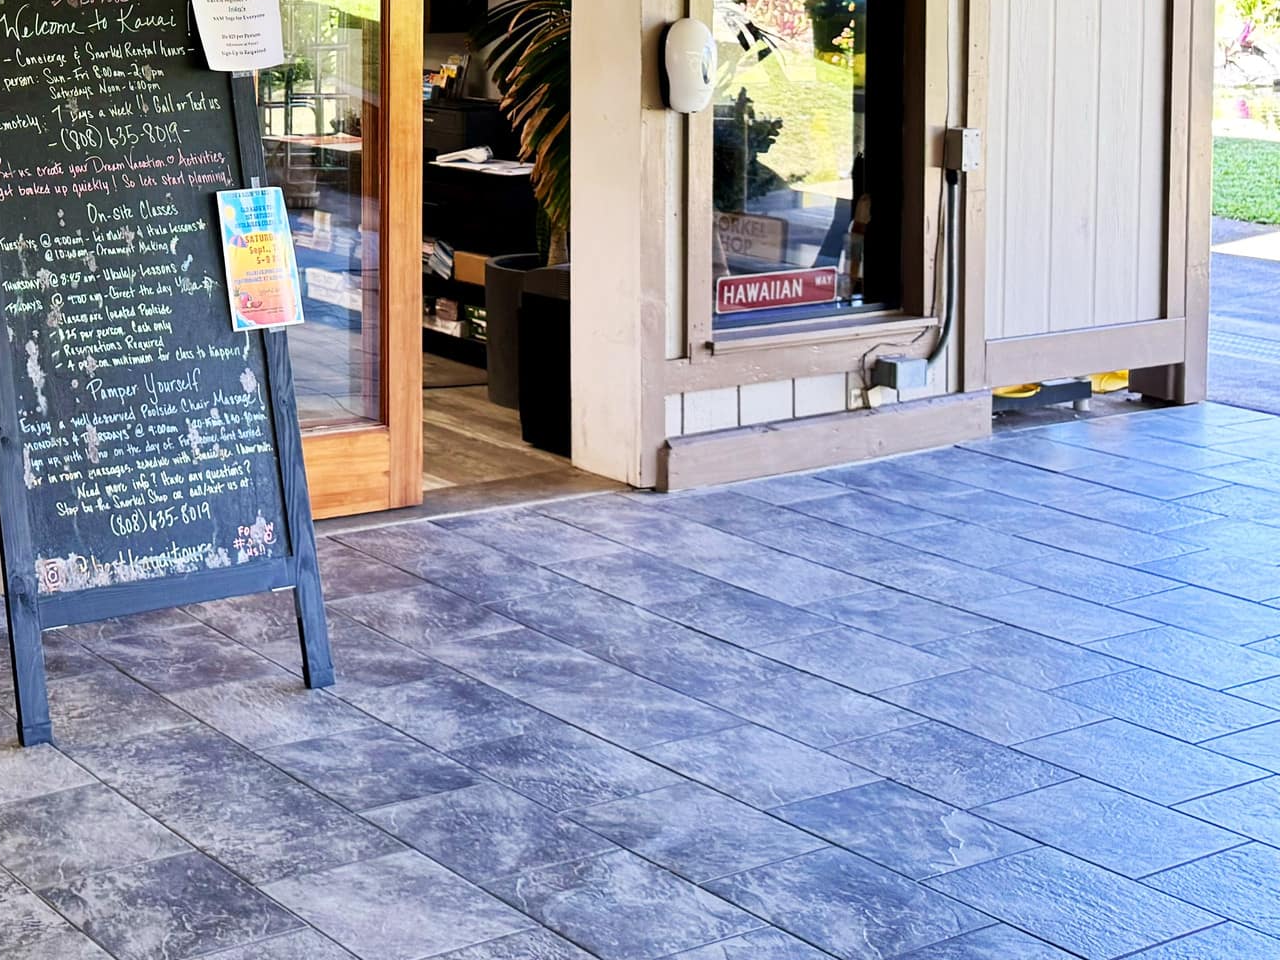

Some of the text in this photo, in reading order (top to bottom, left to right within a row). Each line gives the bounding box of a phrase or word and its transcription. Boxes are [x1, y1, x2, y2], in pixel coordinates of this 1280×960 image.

[88, 9, 108, 32] to
[15, 48, 67, 67] Concierge
[124, 40, 157, 58] Rental
[49, 86, 94, 100] Saturdays
[98, 110, 106, 118] a
[153, 93, 175, 113] Call
[176, 101, 187, 111] or
[210, 97, 221, 110] us
[18, 167, 32, 179] us
[37, 161, 64, 177] create
[69, 163, 88, 178] your
[178, 148, 225, 167] Activities
[18, 182, 51, 196] booked
[54, 184, 68, 197] up
[139, 199, 179, 219] Classes
[146, 224, 168, 237] Hula
[713, 216, 765, 236] ORKEL
[720, 234, 752, 256] HOP
[2, 279, 46, 293] THURSDAY
[723, 274, 833, 305] HAWAIIAN WAY
[197, 345, 206, 359] to
[86, 368, 201, 405] Pamper Yourself
[20, 418, 52, 436] Enjoy
[140, 403, 178, 418] Poolside
[181, 398, 210, 413] Chair
[30, 458, 44, 473] ign
[77, 482, 100, 499] Need
[160, 471, 184, 486] Have
[56, 502, 79, 517] Stop
